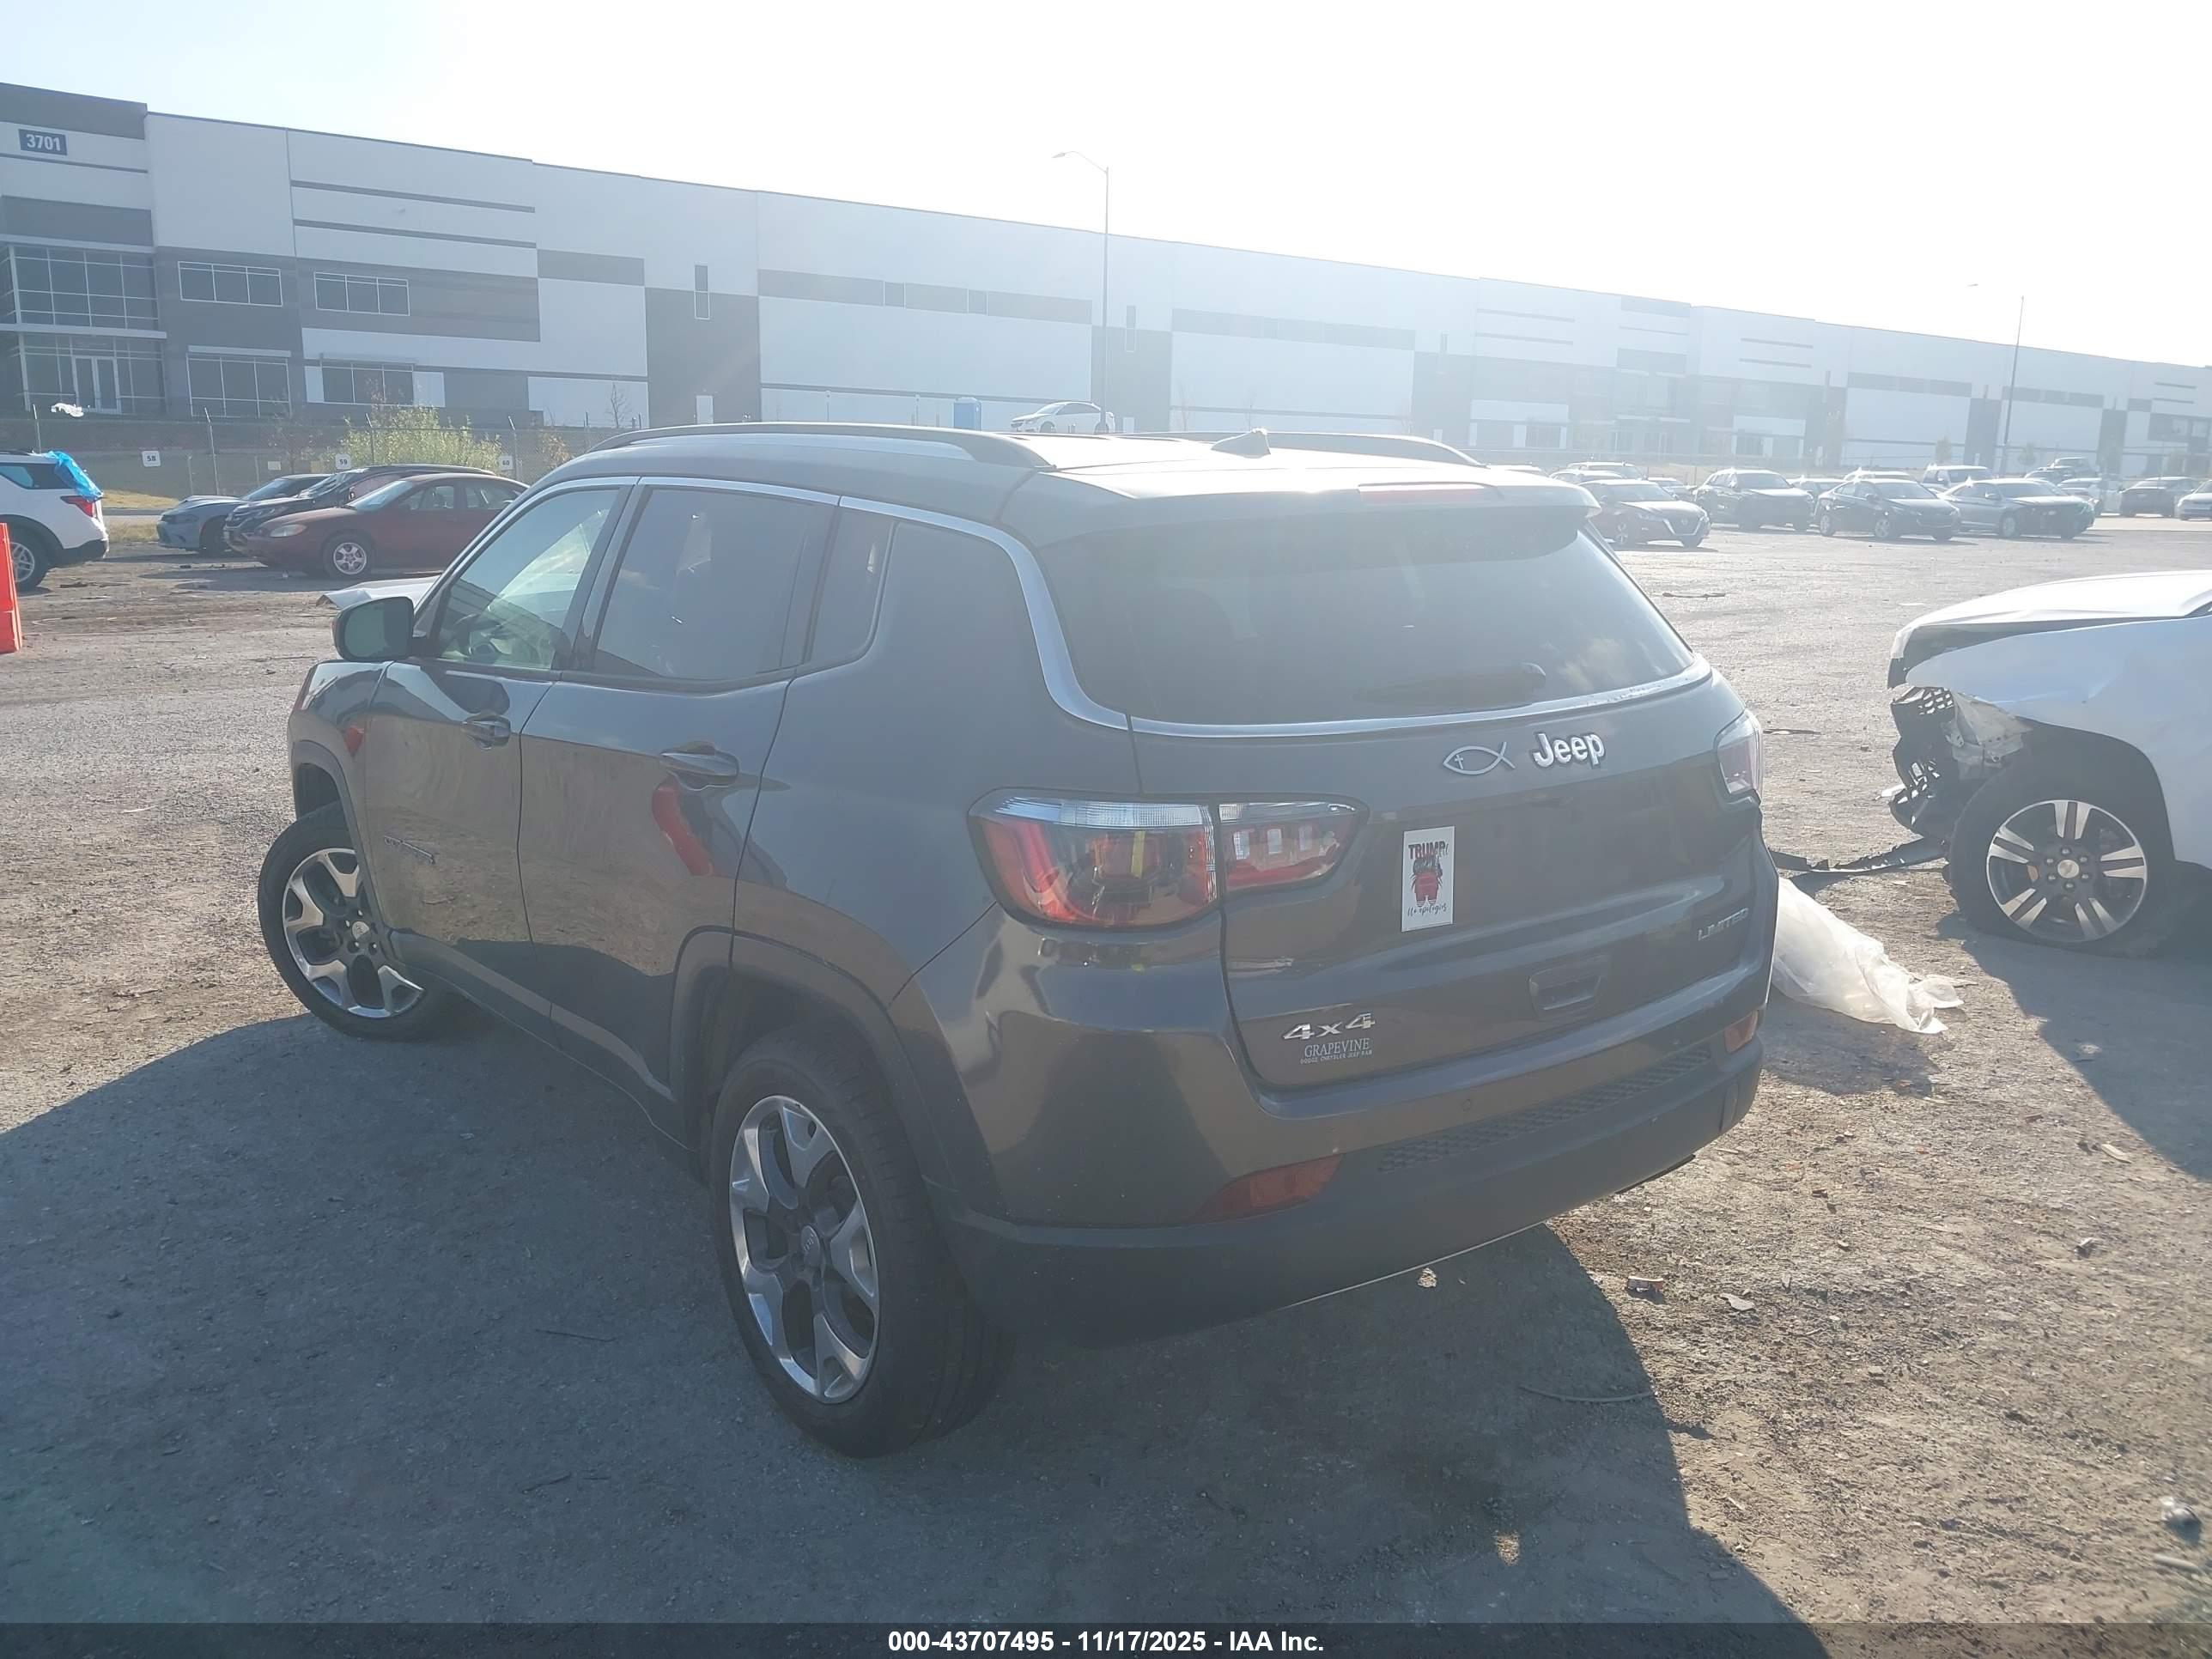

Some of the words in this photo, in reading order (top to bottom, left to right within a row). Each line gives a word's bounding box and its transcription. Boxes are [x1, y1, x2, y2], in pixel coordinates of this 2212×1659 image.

[26, 134, 61, 152] 3701
[1532, 732, 1605, 769] Jeep
[1304, 1038, 1370, 1058] GRAPEVINE
